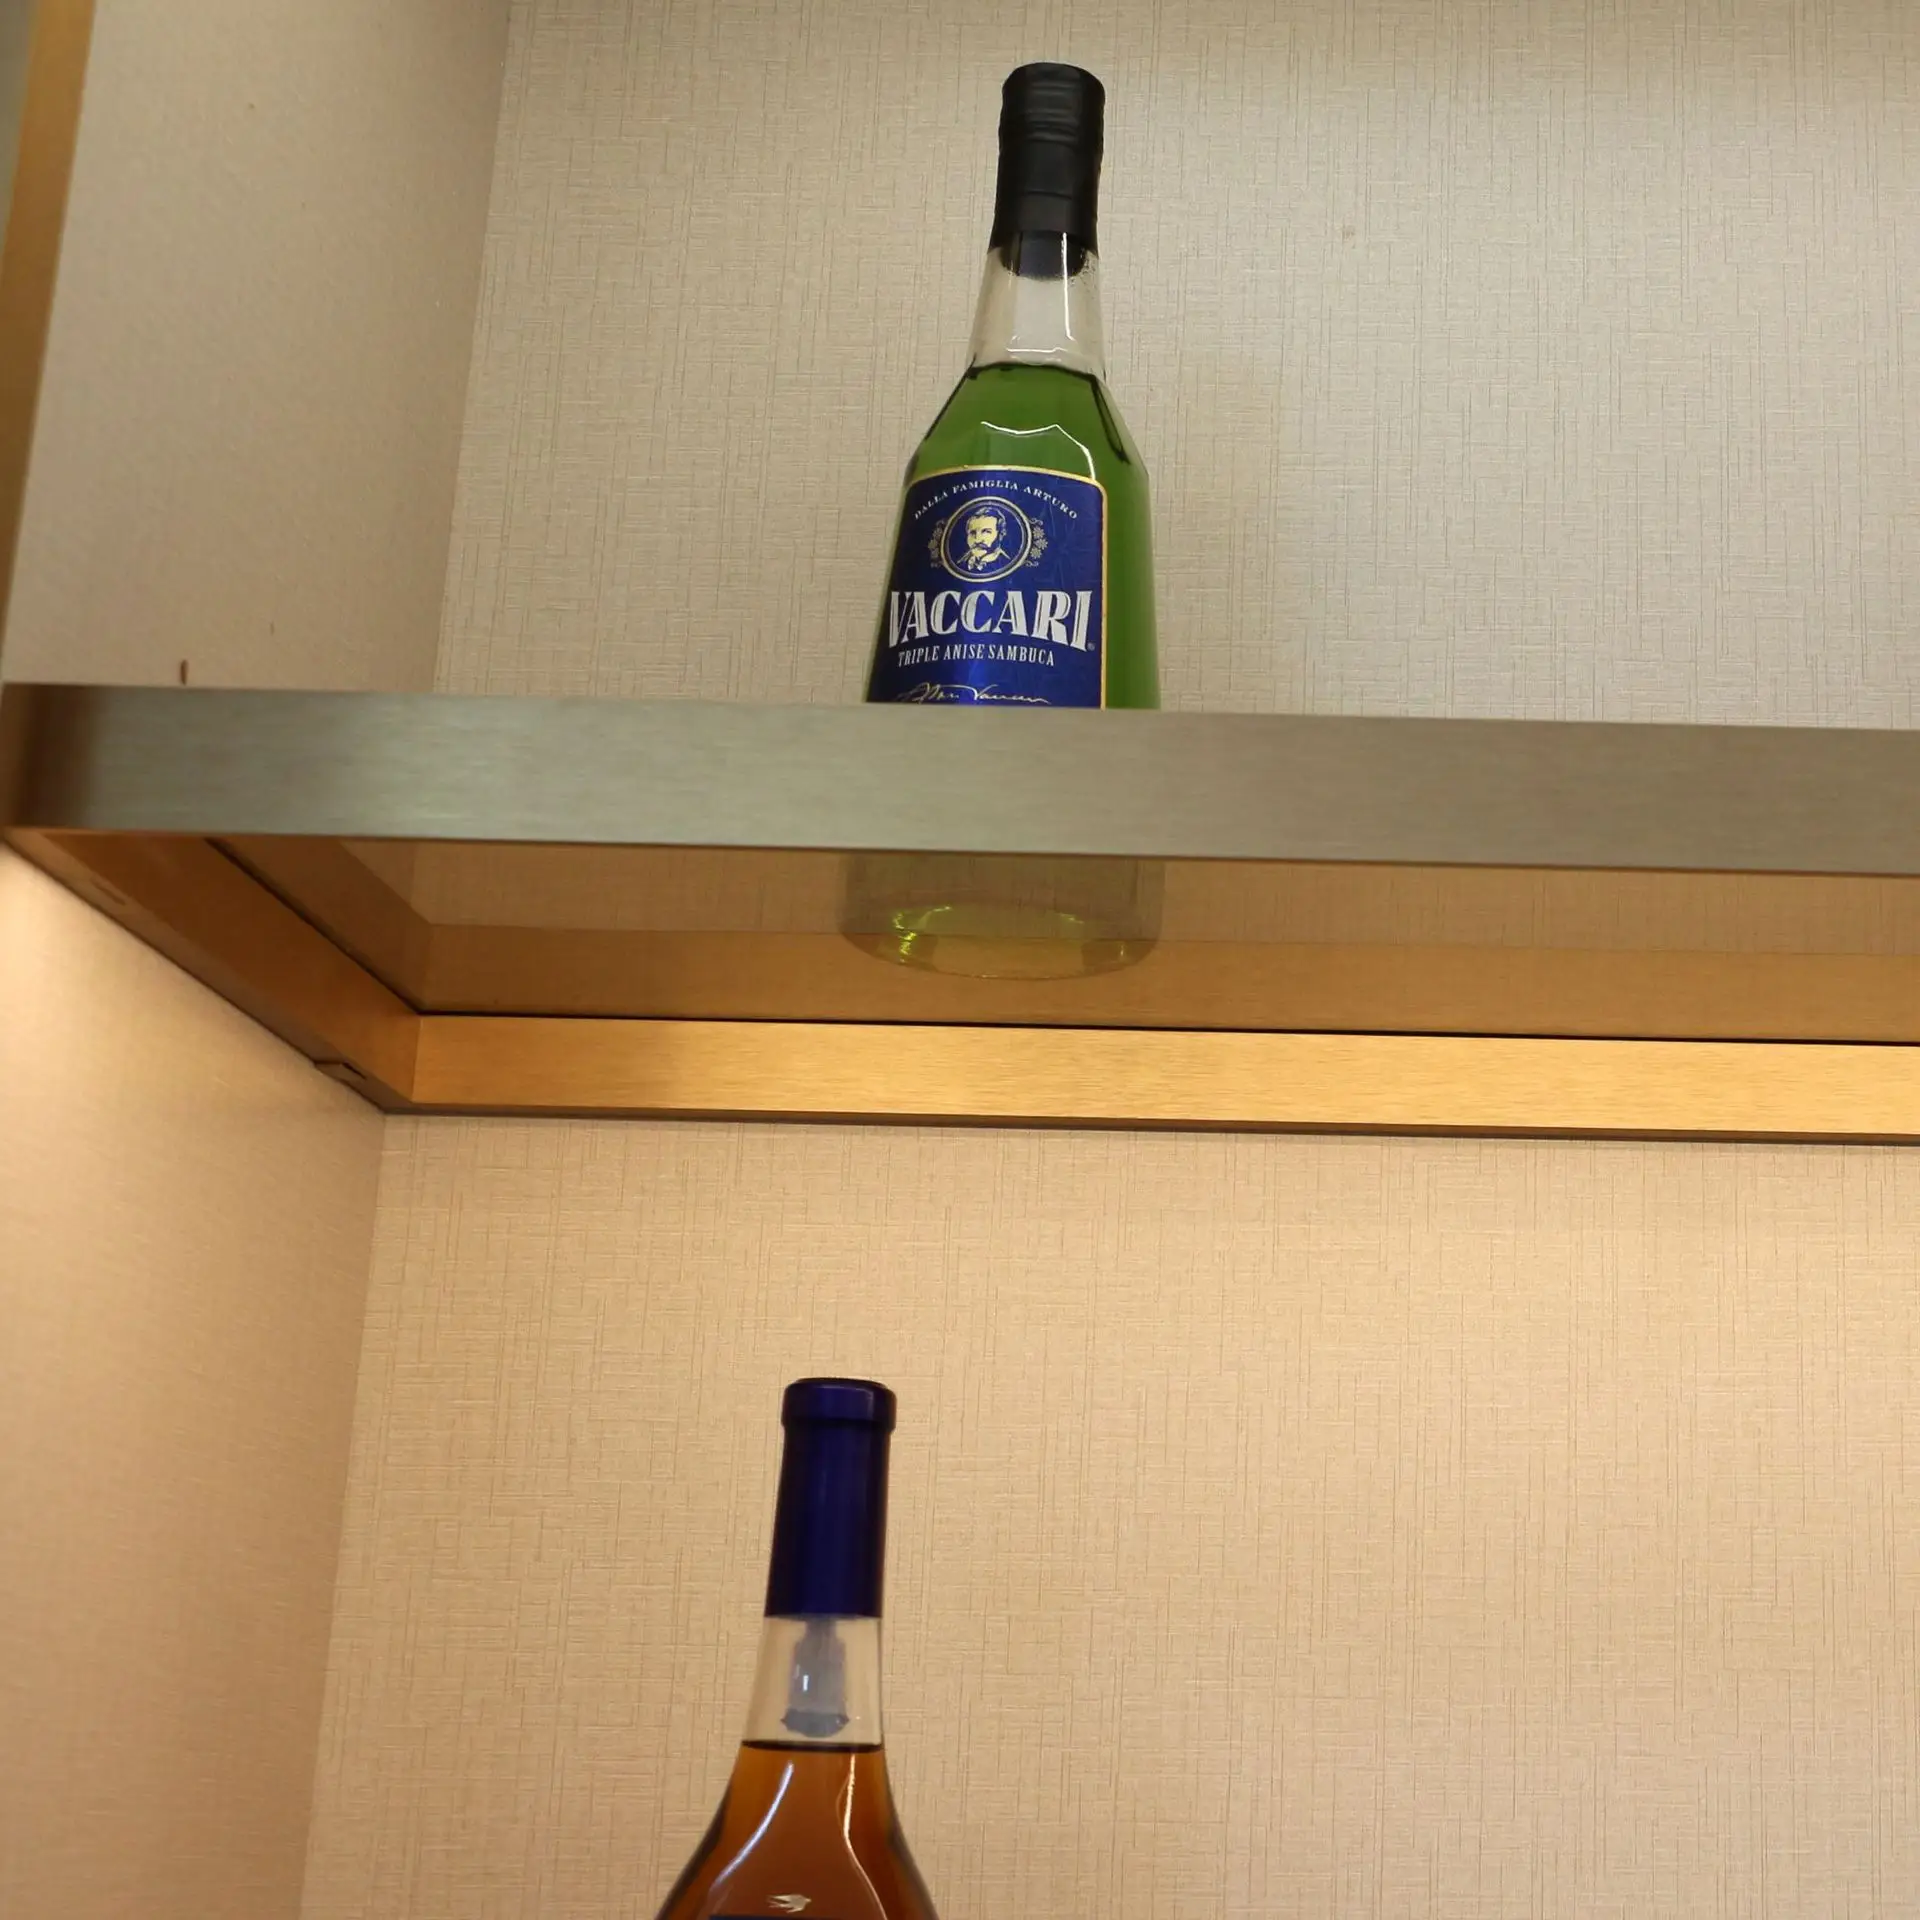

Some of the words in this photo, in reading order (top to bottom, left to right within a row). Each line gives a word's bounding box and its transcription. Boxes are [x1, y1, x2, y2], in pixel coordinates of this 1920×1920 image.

[914, 491, 949, 520] DALLA
[952, 480, 1018, 495] FAMIGLIA
[1023, 484, 1078, 520] ARTURO
[889, 590, 1092, 652] VACCARI
[898, 645, 939, 668] TRIPLE
[943, 643, 986, 661] ANISE
[988, 645, 1054, 668] SAMBUCA
